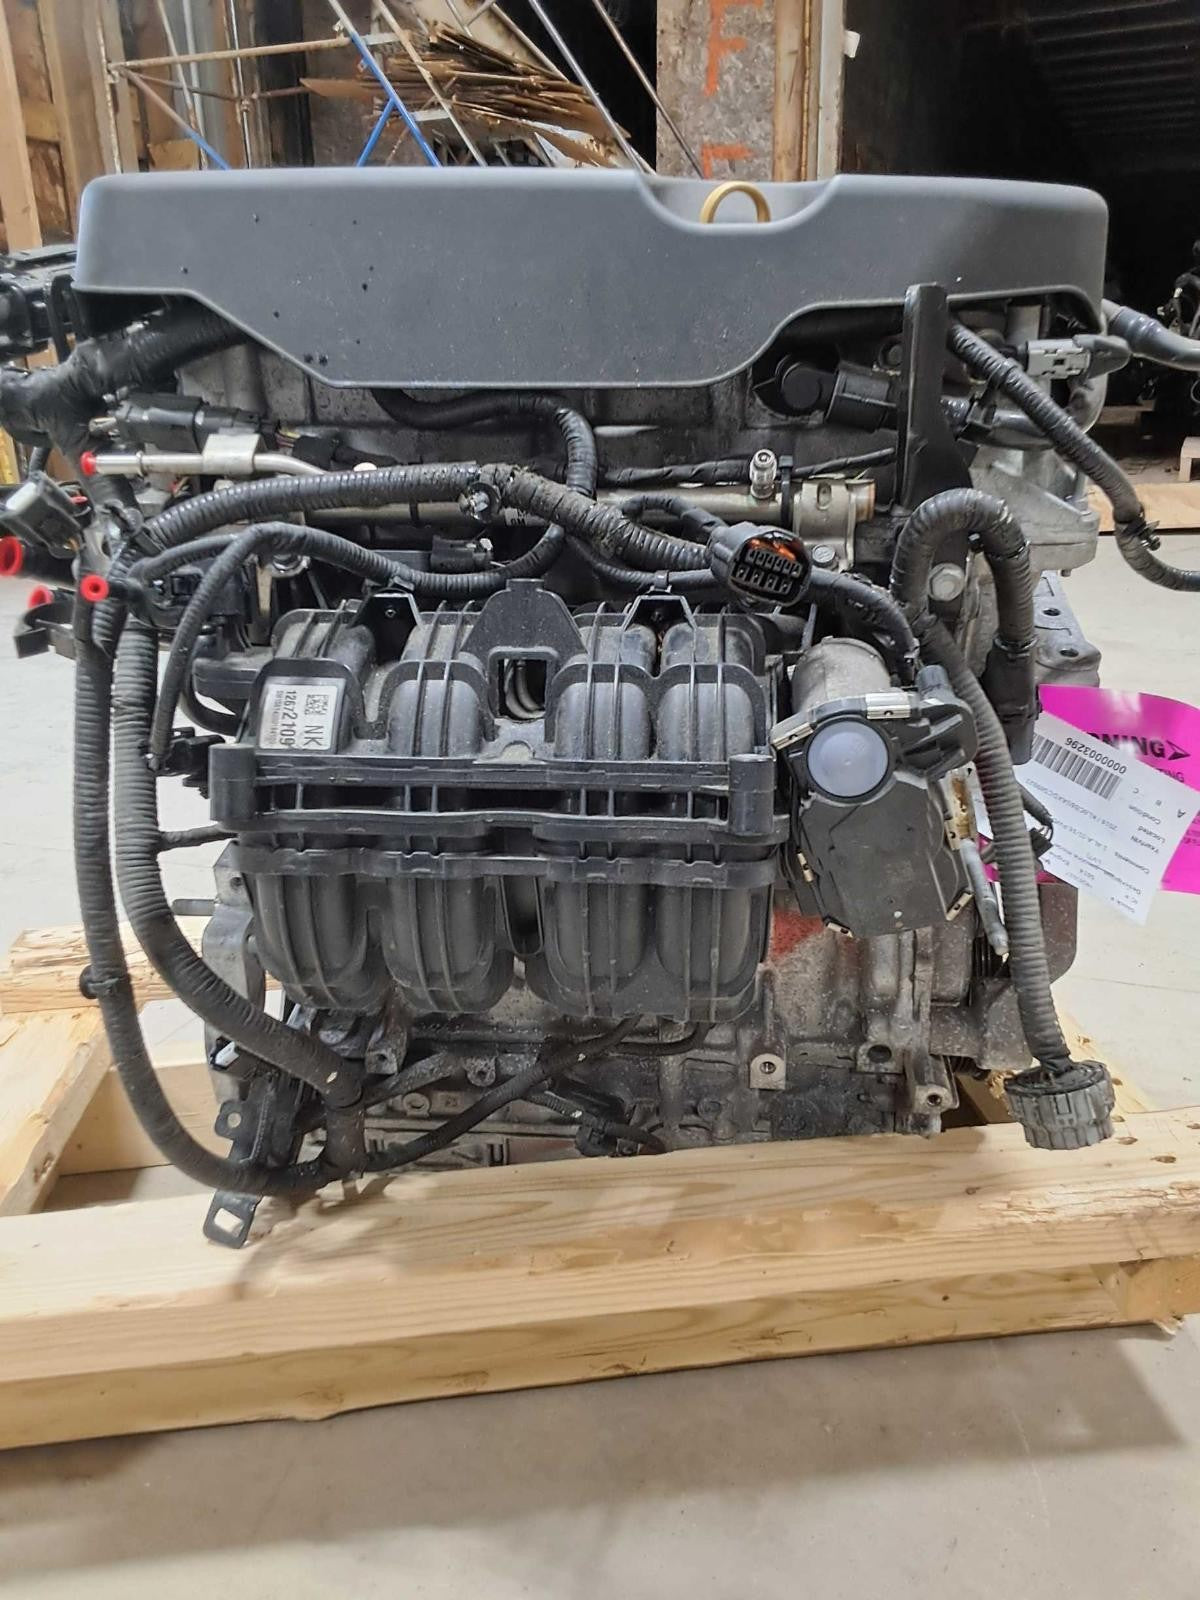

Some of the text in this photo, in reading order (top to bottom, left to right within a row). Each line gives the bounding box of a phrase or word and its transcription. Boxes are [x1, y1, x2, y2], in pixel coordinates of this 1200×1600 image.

[279, 690, 298, 746] 12672109
[303, 725, 325, 746] NK
[1066, 737, 1127, 774] 0000003296
[1132, 787, 1140, 795] C
[1128, 804, 1162, 825] Condition
[1176, 808, 1186, 819] A
[1138, 825, 1166, 843] Located
